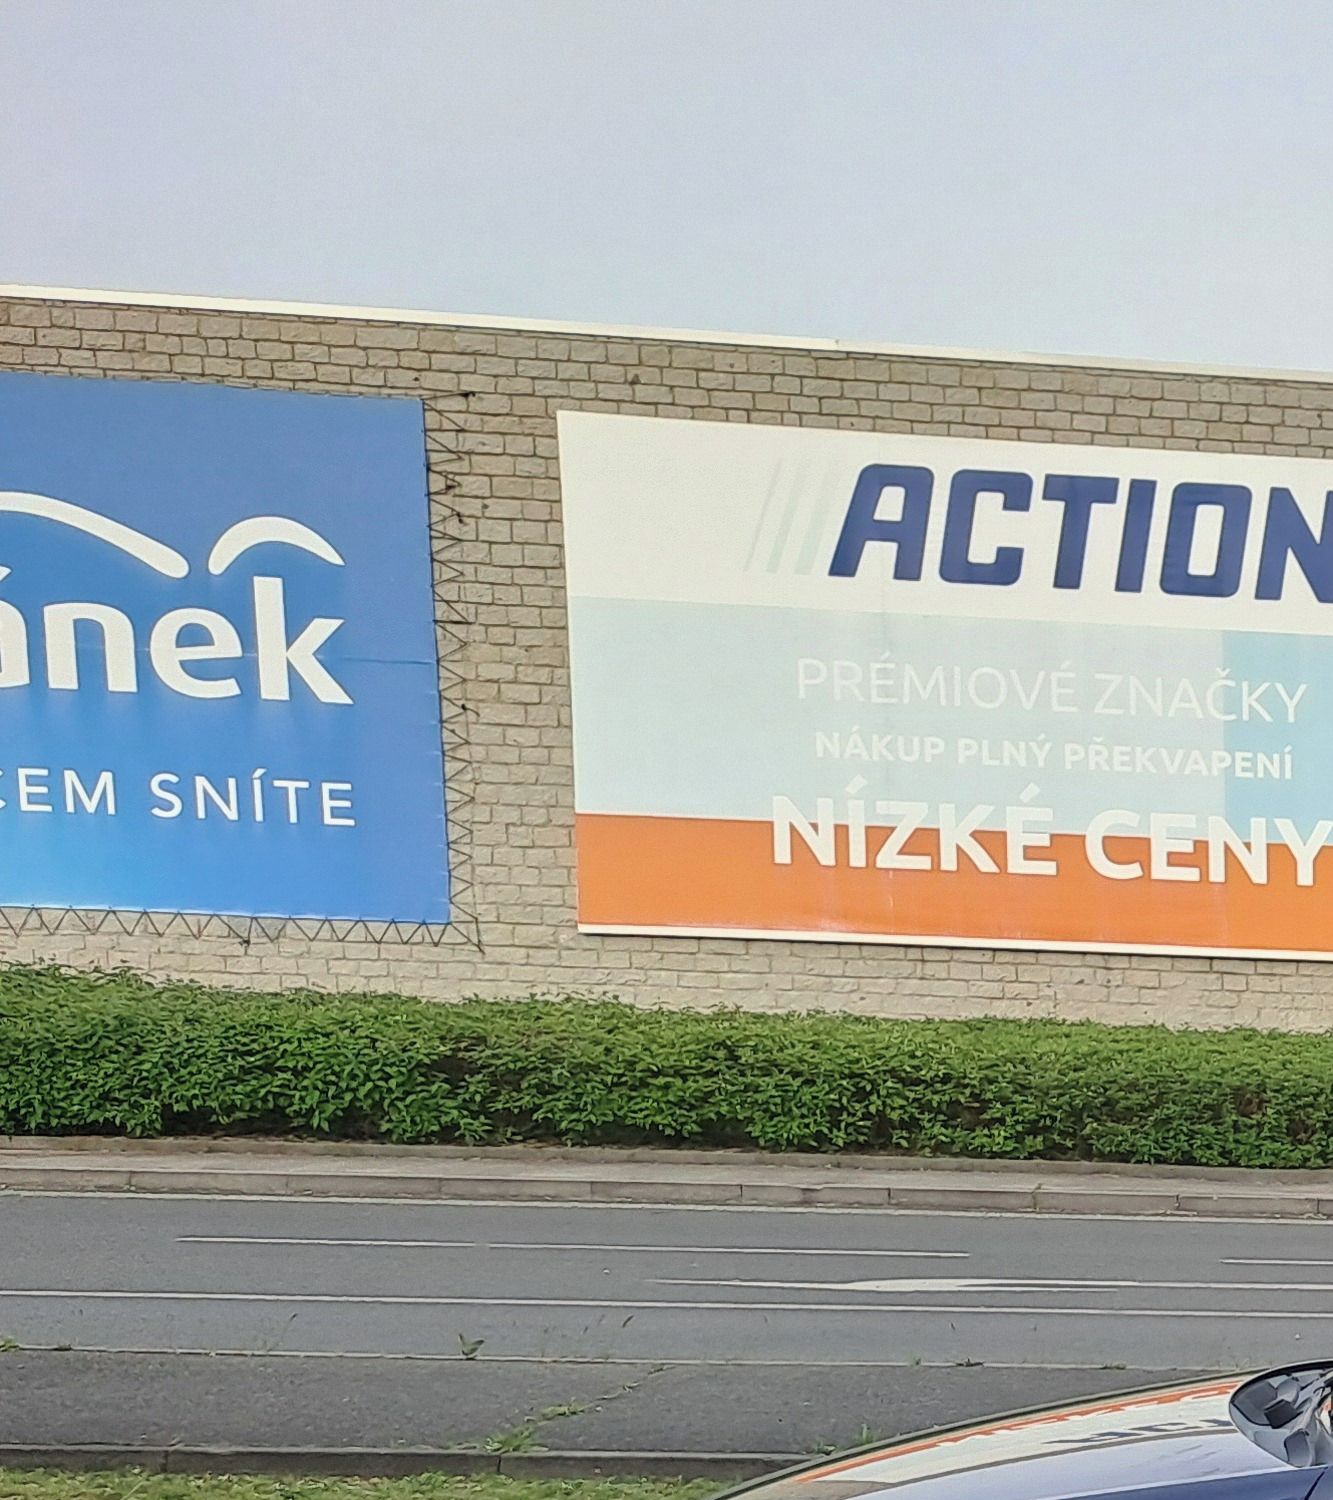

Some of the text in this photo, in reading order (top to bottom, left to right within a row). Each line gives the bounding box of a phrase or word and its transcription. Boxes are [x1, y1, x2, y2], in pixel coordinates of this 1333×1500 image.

[796, 650, 1308, 723] PRÉMIOVÉ ZNAČKY
[815, 725, 1294, 780] NÁKUP PLNÝ PŘEKVAPENÍ
[0, 767, 356, 827] EM SNÍTE
[772, 773, 1058, 876] NÍZKÉ
